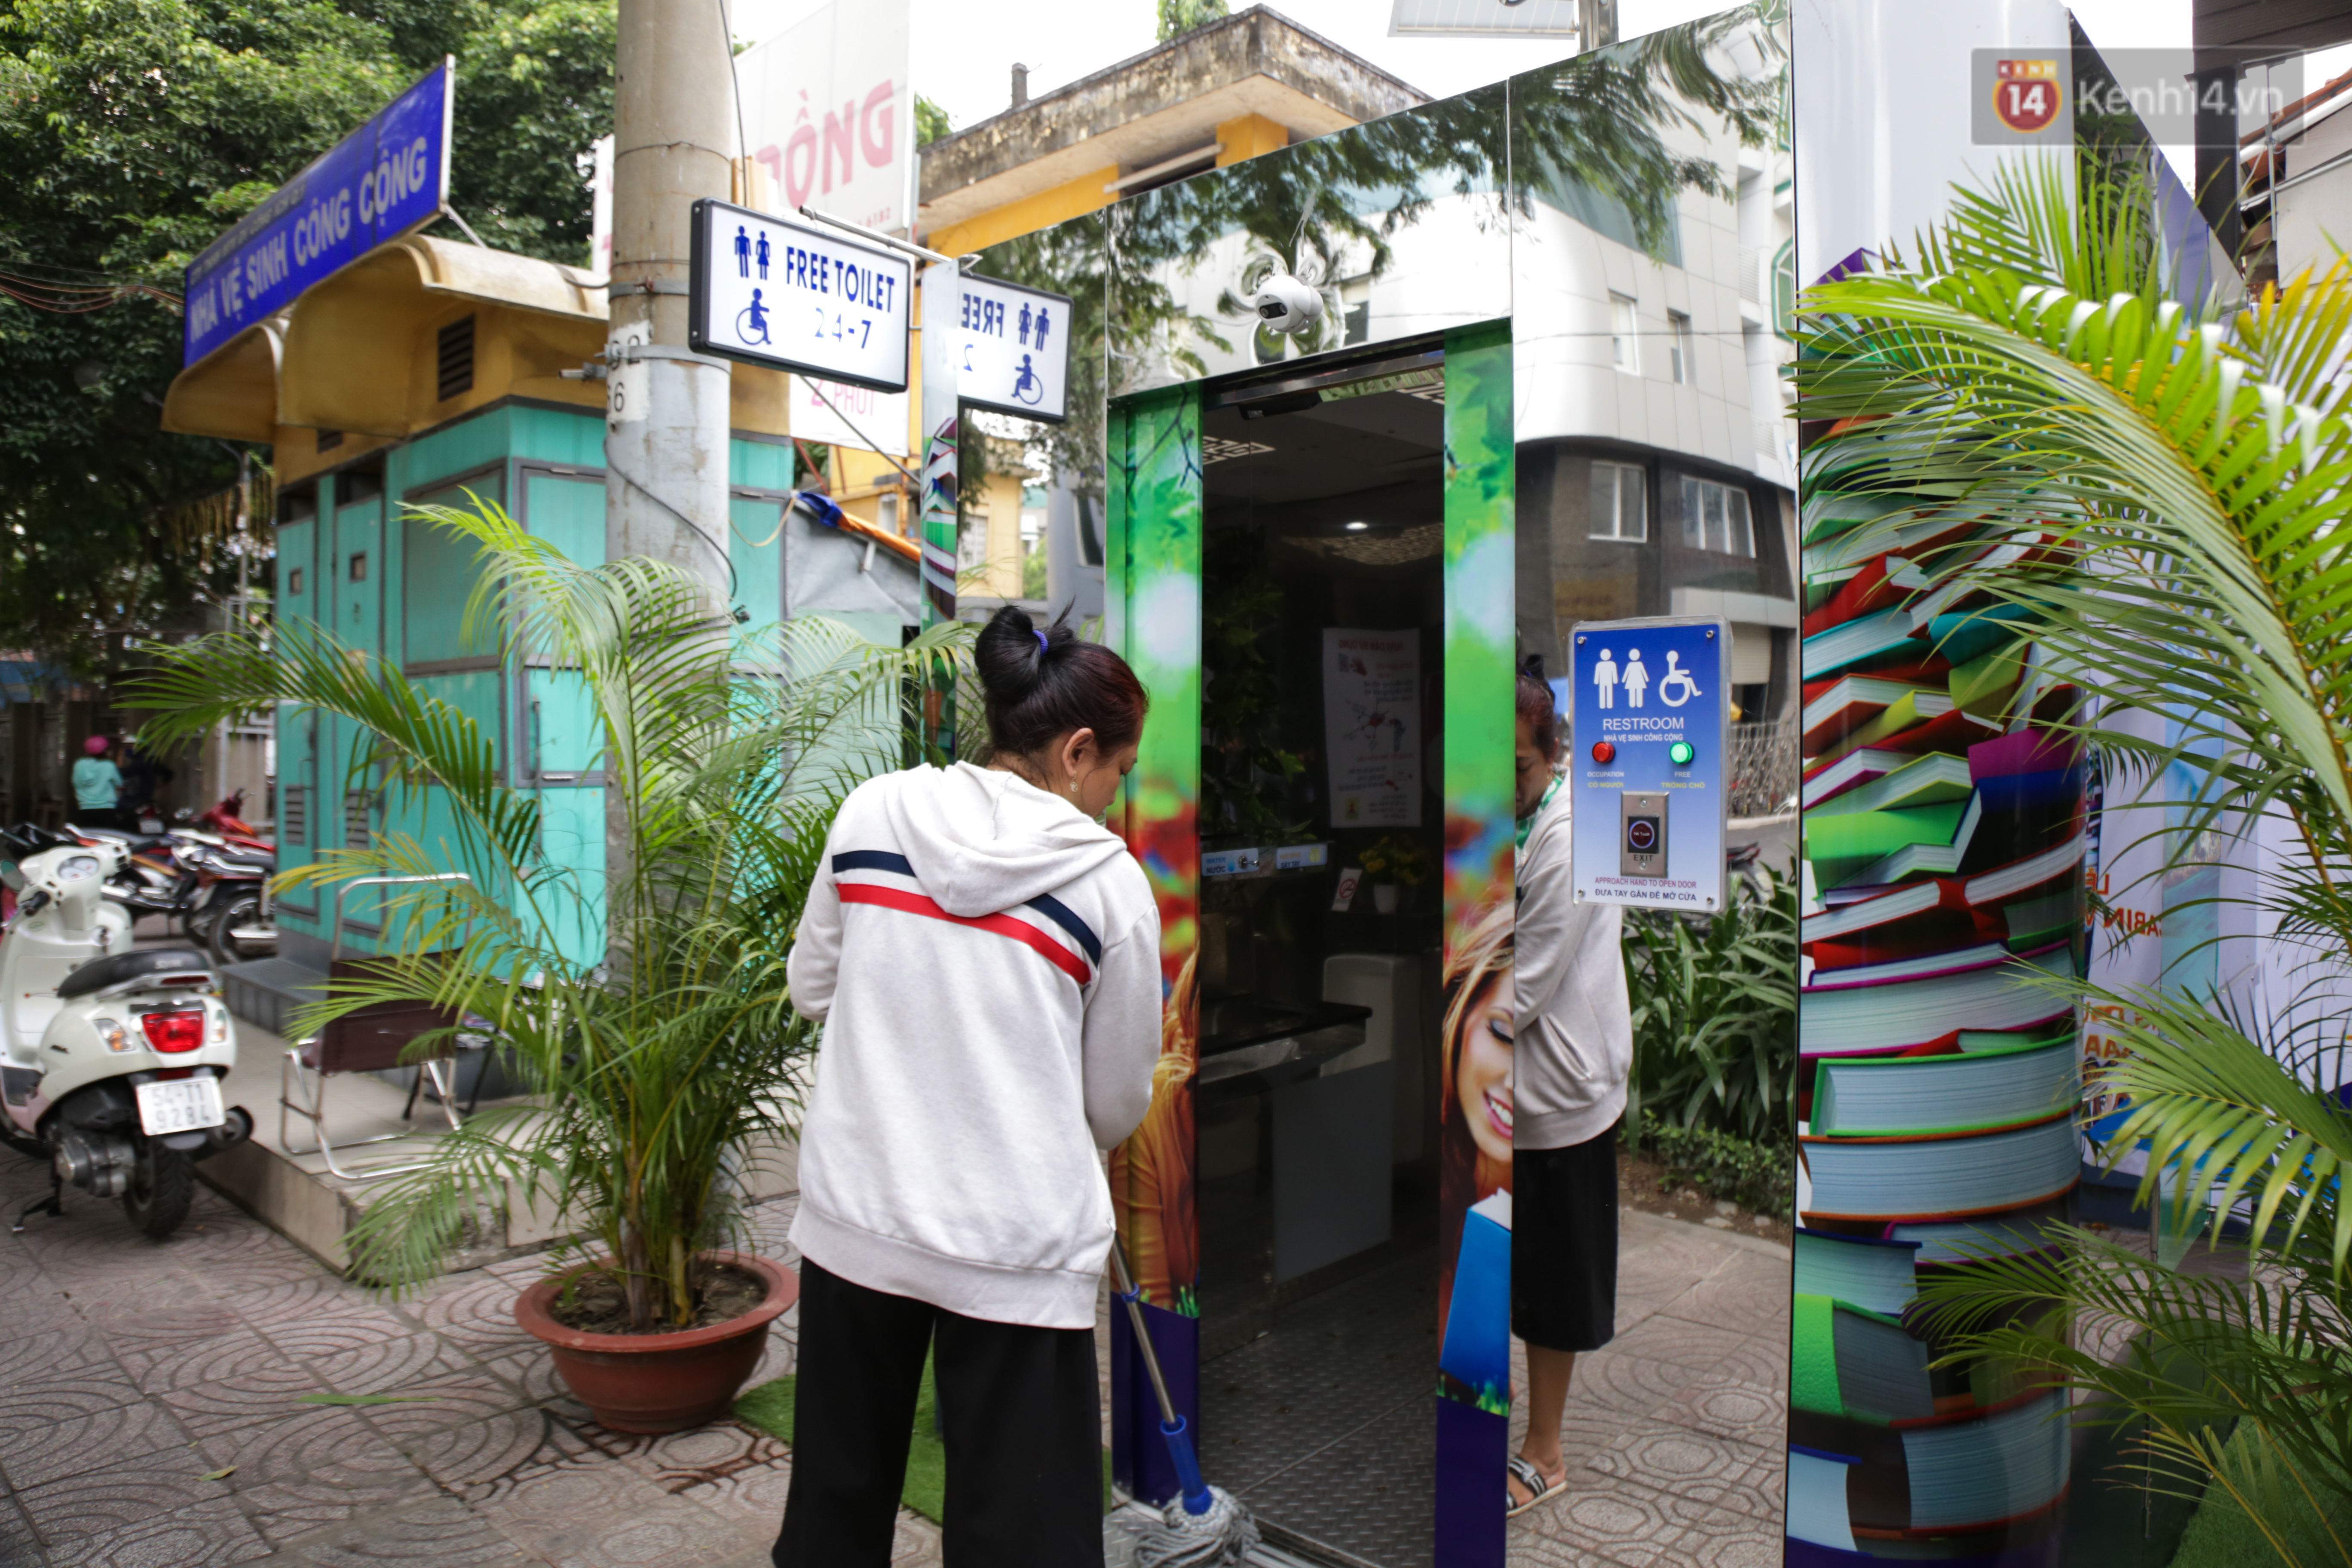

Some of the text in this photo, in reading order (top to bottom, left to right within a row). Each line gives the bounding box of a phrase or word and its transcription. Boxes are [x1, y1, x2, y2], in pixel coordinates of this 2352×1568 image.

[221, 257, 242, 322] VỆ
[246, 230, 288, 300] SINH
[294, 188, 351, 267] CÔNG
[358, 136, 427, 227] CỘNG
[787, 246, 895, 312] FREE TOILET
[1603, 717, 1684, 730] RESTROOM
[1604, 733, 1617, 742] NHÀ
[1618, 734, 1626, 742] VỆ
[1644, 732, 1663, 741] CÔNG
[1664, 733, 1684, 742] CỘNG
[1595, 877, 1628, 885] APPROACH
[1630, 878, 1647, 886] HAND
